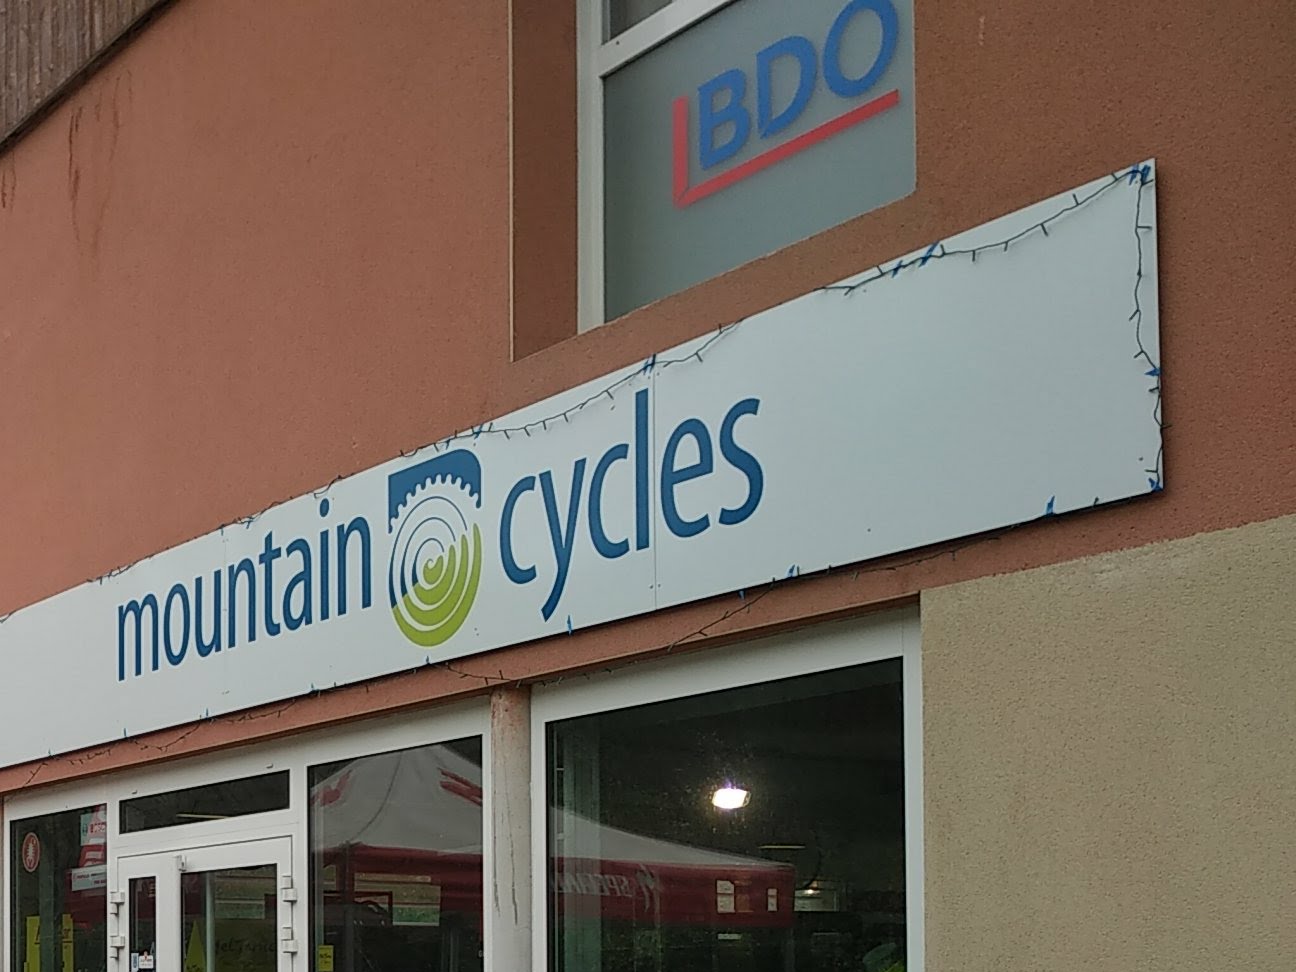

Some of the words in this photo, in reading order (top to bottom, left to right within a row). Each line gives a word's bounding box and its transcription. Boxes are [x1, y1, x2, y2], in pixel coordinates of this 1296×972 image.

[698, 0, 899, 171] BDO
[116, 498, 373, 682] mountain
[500, 388, 766, 620] cycles
